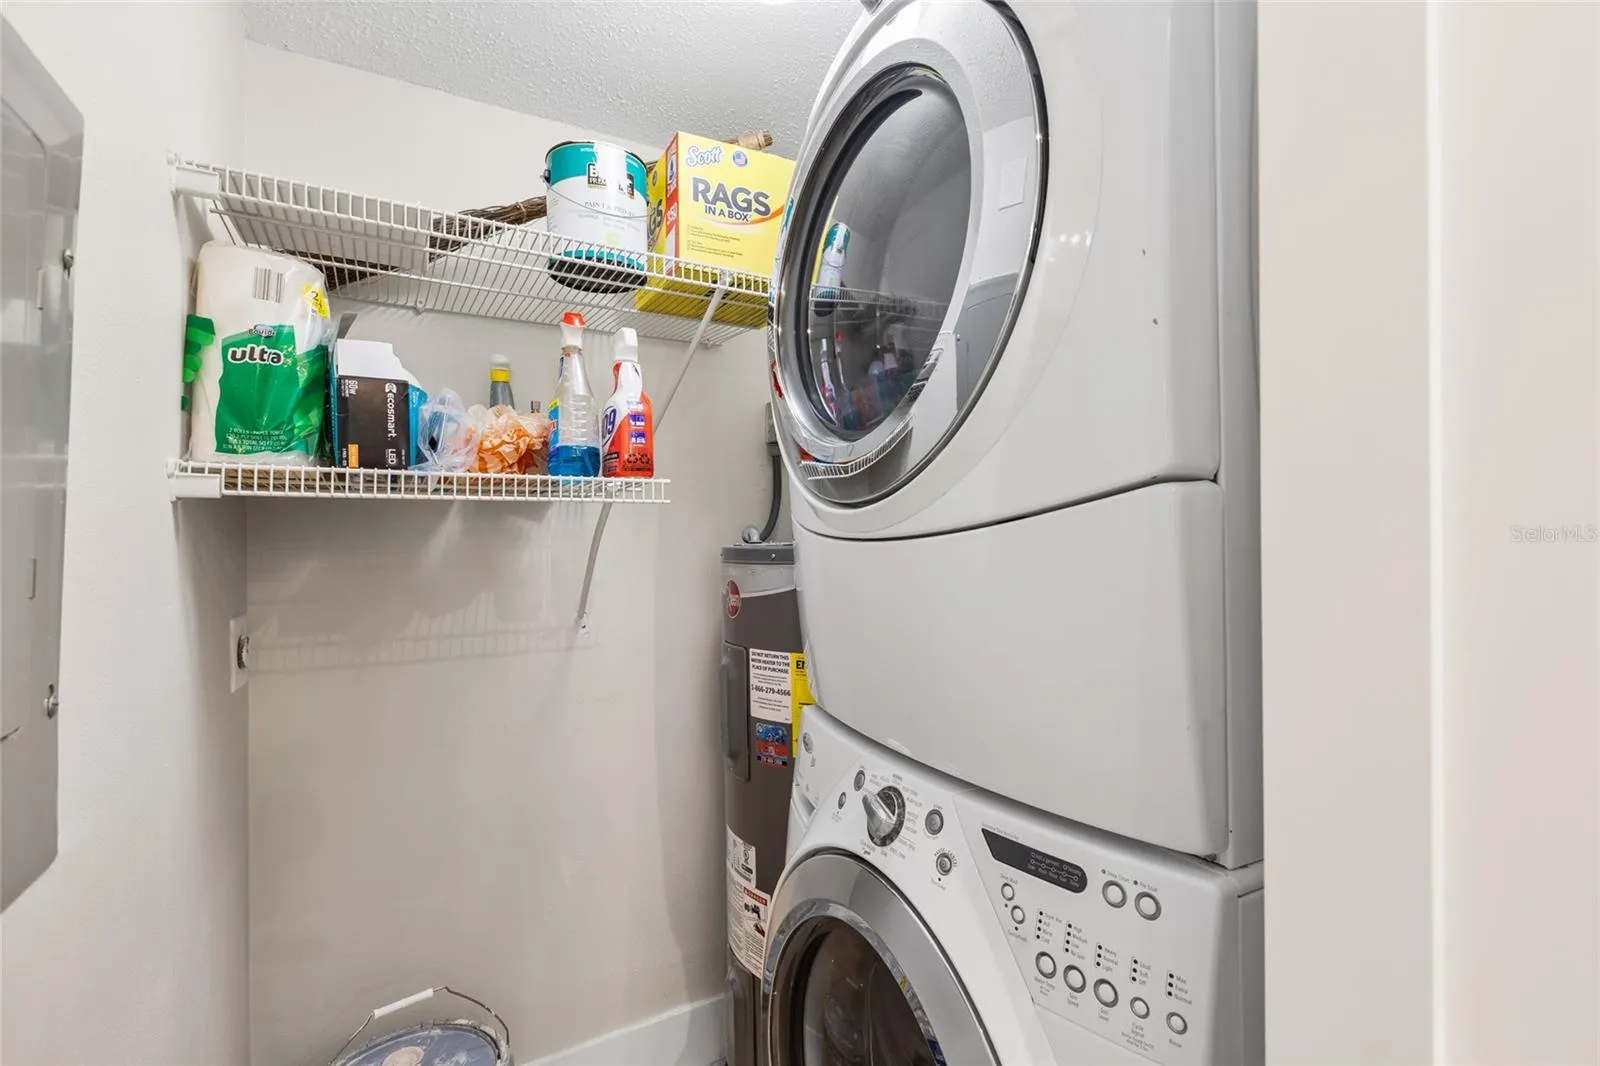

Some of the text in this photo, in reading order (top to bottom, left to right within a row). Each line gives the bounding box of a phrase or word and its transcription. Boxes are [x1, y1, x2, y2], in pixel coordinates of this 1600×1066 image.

[686, 146, 723, 166] Scott
[692, 176, 771, 217] RAGS
[705, 204, 750, 222] IN A BOX
[230, 346, 282, 364] ultra
[387, 393, 397, 437] ecosmart
[388, 448, 397, 465] LED
[768, 666, 789, 674] PURCHASE
